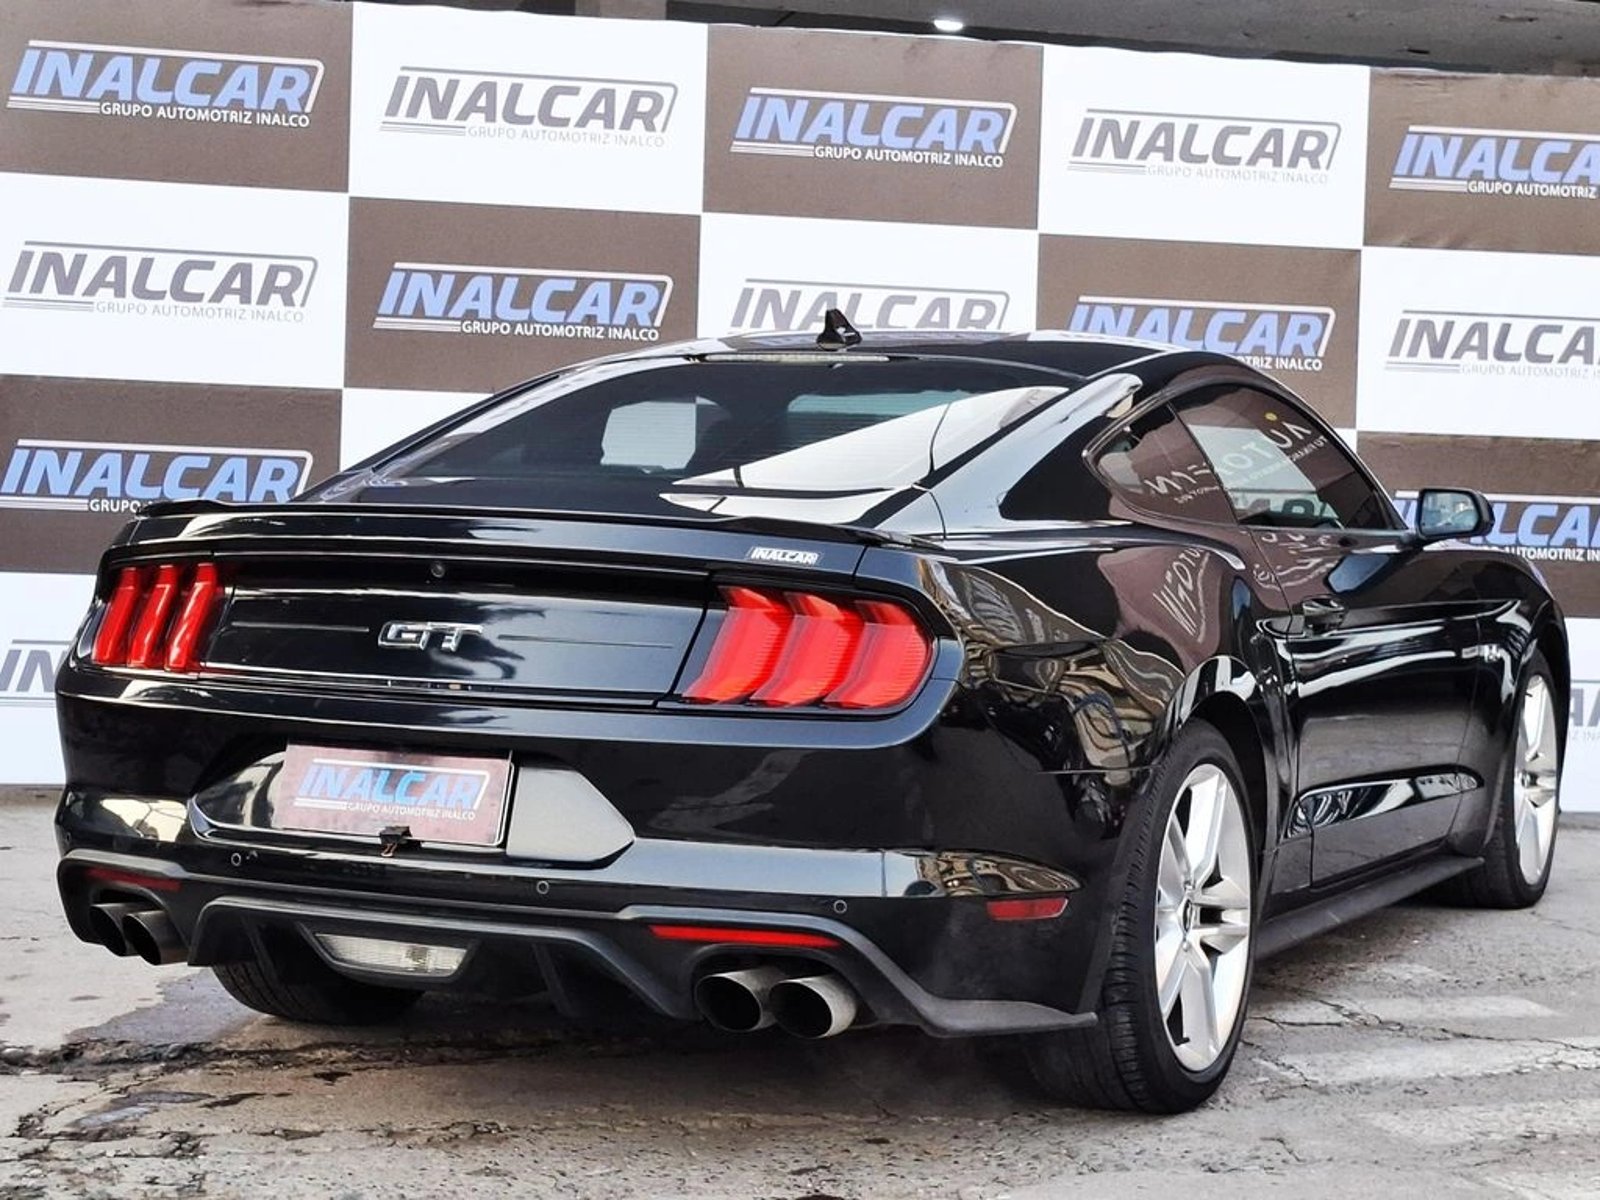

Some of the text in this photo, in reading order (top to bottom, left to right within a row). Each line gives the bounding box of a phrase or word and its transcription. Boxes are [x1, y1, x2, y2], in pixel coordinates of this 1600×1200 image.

[11, 48, 311, 112] INALCAR
[101, 102, 310, 128] GRUPO AUTOMOTRIZ INALCO
[384, 75, 665, 133] INALCAR
[468, 126, 665, 148] GRUPO AUTOMOTRIZ INALCO
[735, 96, 1004, 153] INALCAR
[815, 145, 1003, 168] GRUPO AUTOMOTRIZ INALCO
[1072, 117, 1329, 170] INALCAR
[1147, 165, 1328, 185] GRUPO AUTOMOTRIZ INALCO
[1468, 180, 1598, 199] GRUPO AUTOMOTRIZ
[7, 250, 304, 308] INALCAR
[96, 301, 304, 323] GRUPO AUTOMOTRIZ INALCO
[378, 271, 661, 327] INALCAR
[462, 320, 659, 342] GRUPO AUTOMOTRIZ INALCO
[1069, 304, 1323, 357] INALCAR
[1388, 318, 1600, 366] INALCA
[1275, 357, 1323, 372] INALCO
[0, 448, 299, 503] INALCAR
[89, 498, 142, 513] GRUPO
[750, 546, 819, 565] INALCAR
[378, 620, 483, 652] GT
[299, 764, 480, 810] INALCAR
